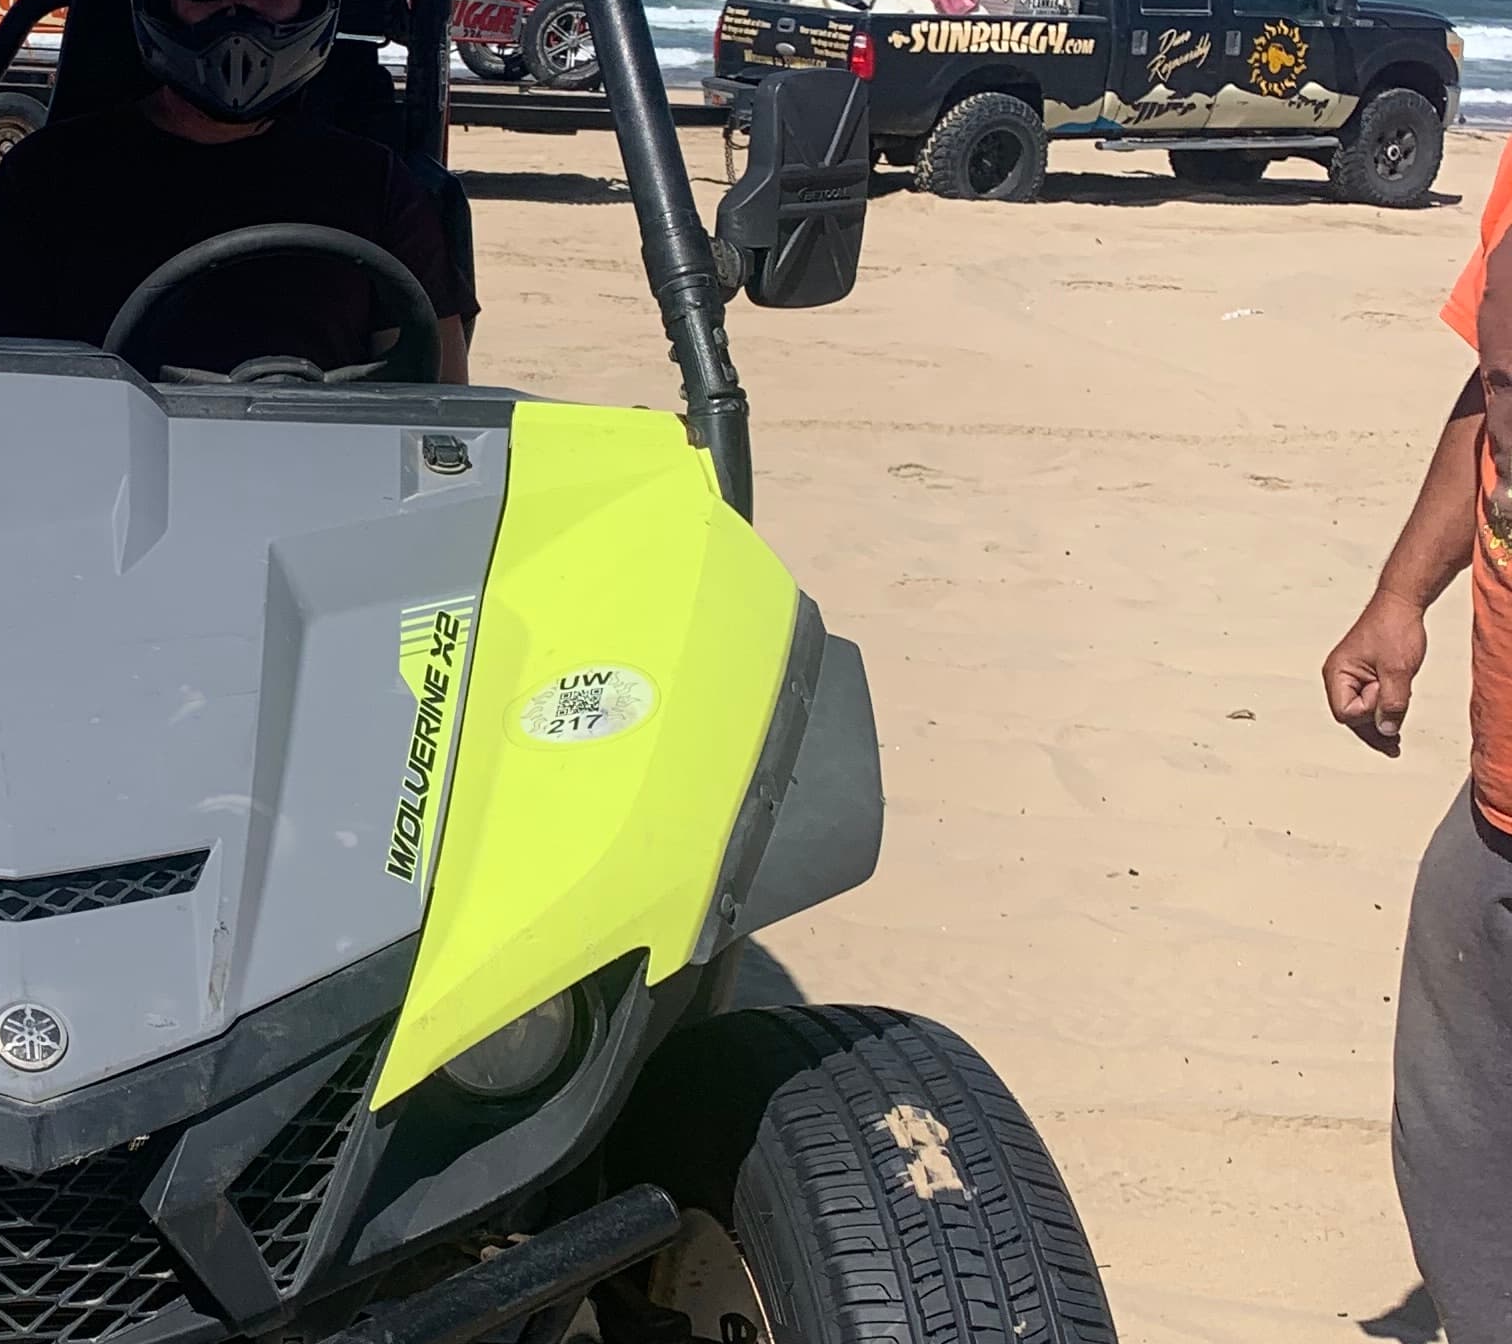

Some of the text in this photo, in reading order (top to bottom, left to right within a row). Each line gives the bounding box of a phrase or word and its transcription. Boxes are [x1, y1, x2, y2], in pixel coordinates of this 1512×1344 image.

[559, 671, 613, 690] UW
[547, 714, 603, 735] 217
[387, 611, 460, 882] WOLVERINE X2
